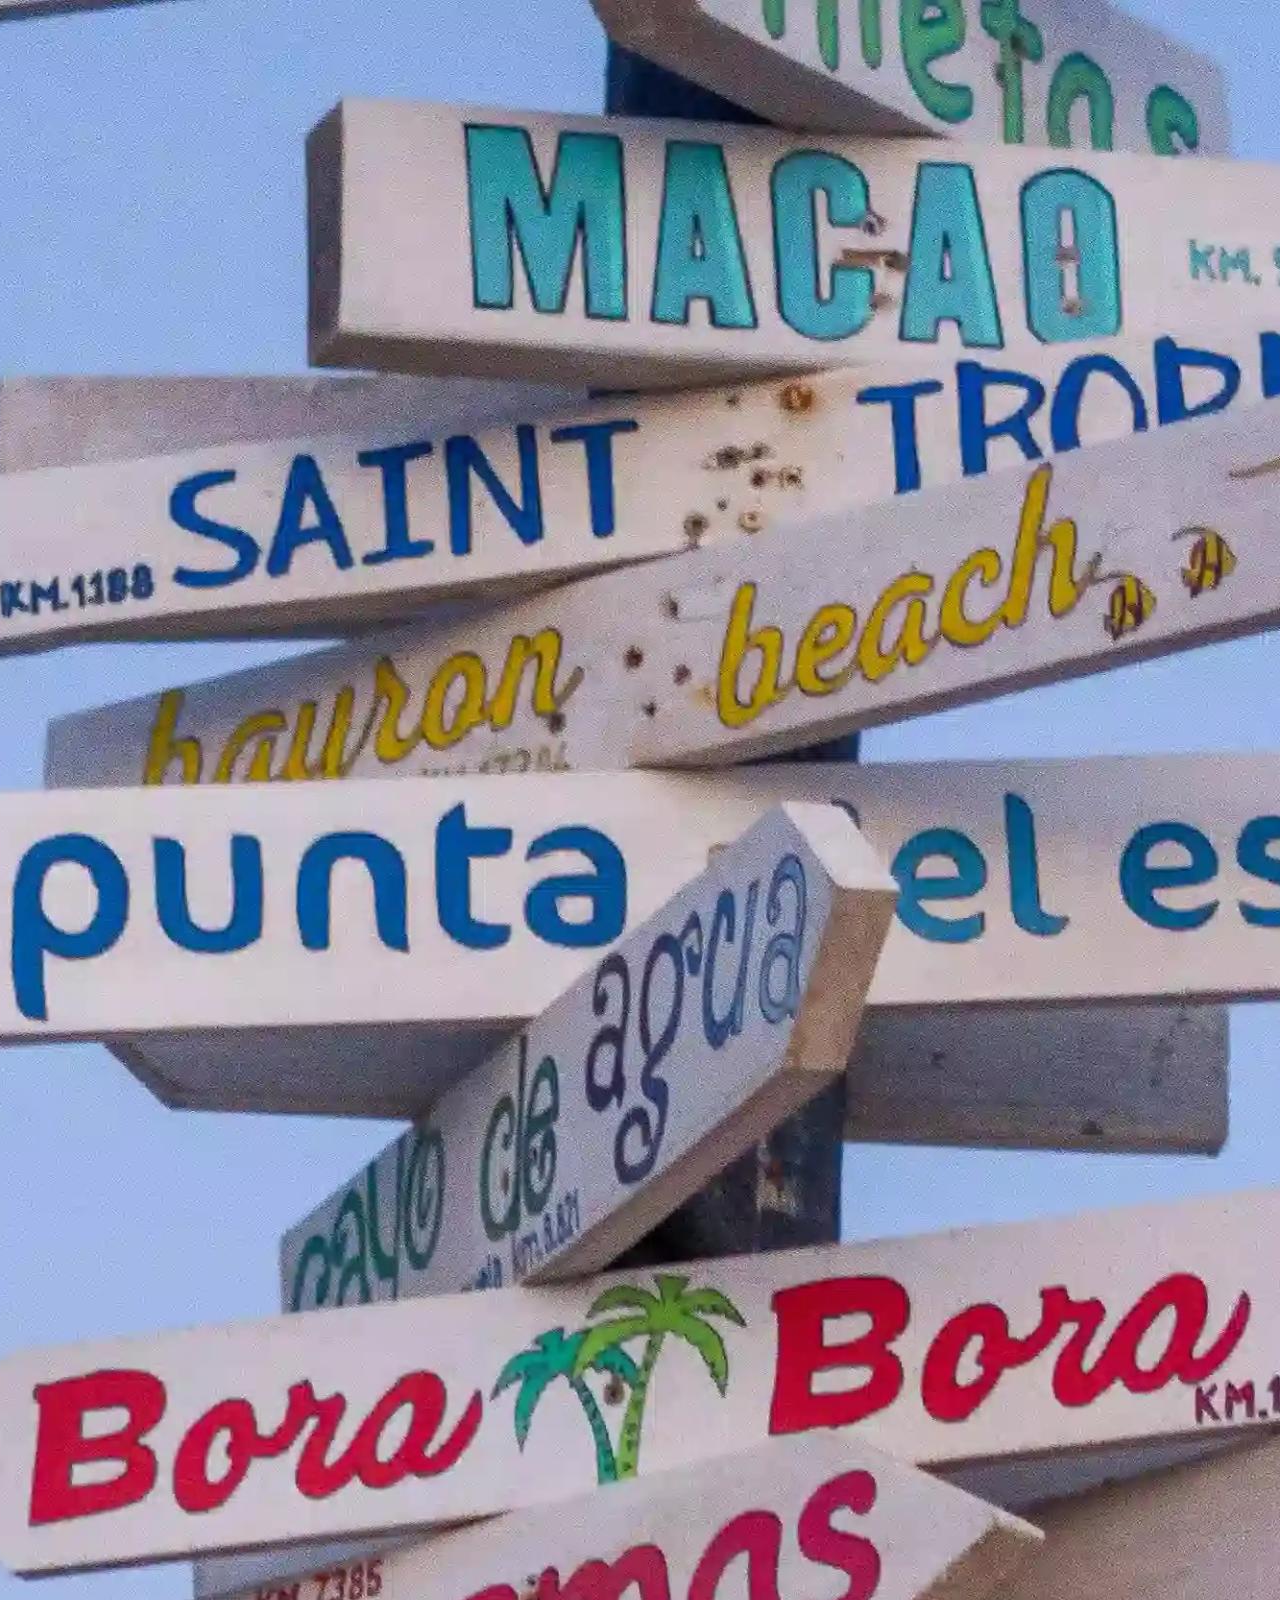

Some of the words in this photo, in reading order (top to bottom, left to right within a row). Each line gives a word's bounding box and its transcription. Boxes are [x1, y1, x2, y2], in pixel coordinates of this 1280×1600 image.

[466, 123, 1123, 349] MACAO
[167, 419, 639, 589] SAINT
[717, 462, 1103, 729] beach
[10, 801, 629, 1022] punta
[890, 793, 1070, 943] el
[28, 1367, 483, 1528] Bora
[768, 1272, 1251, 1436] Bora
